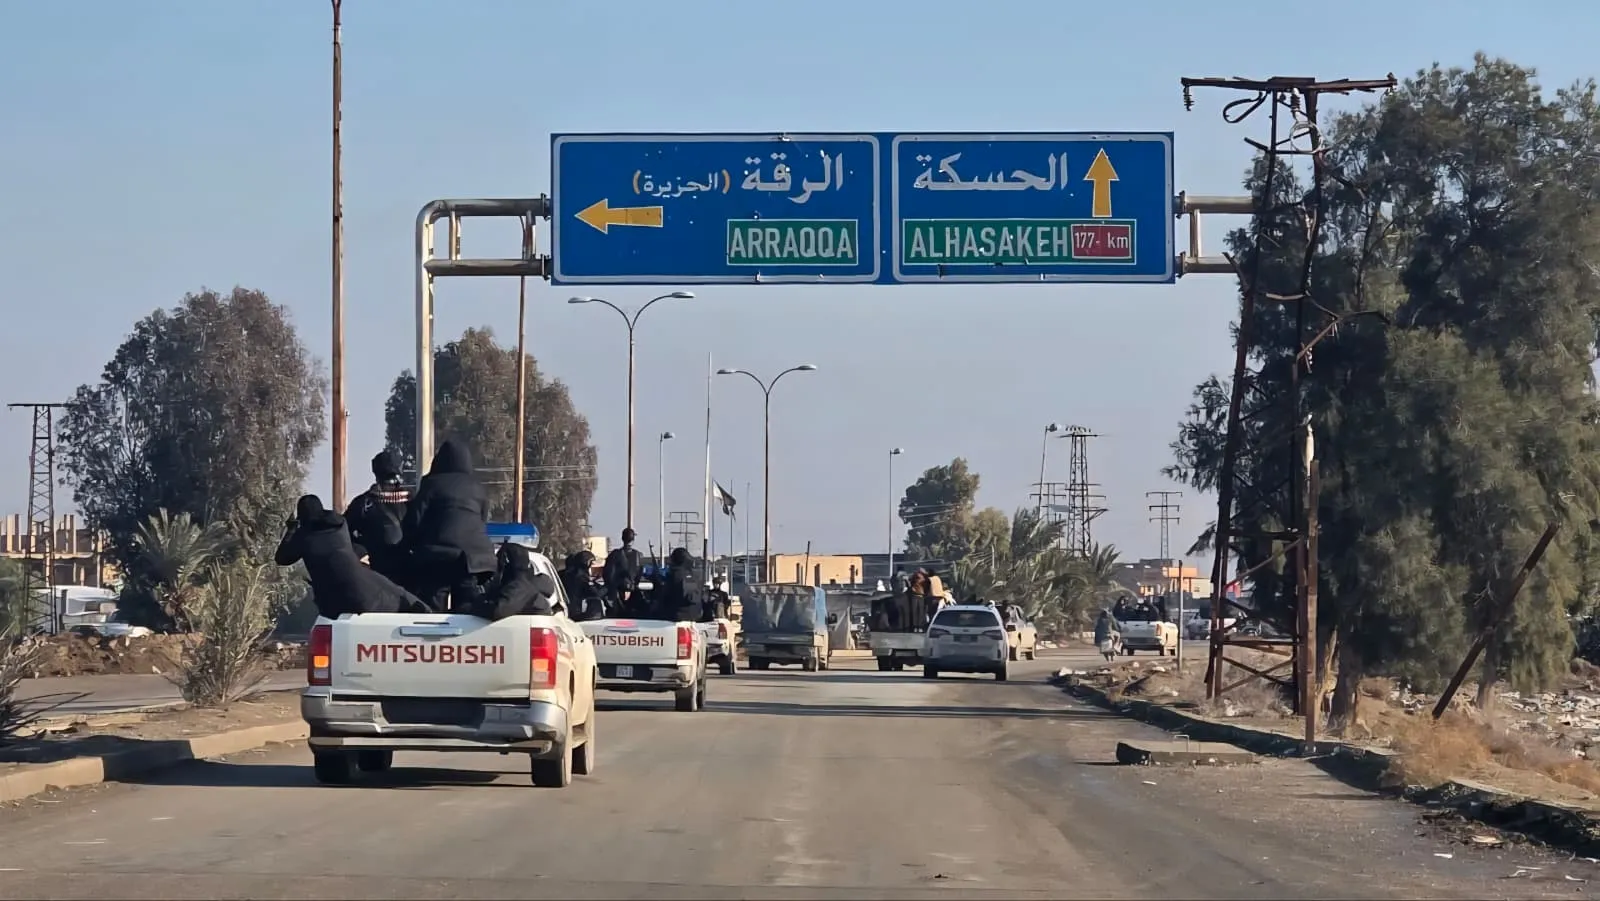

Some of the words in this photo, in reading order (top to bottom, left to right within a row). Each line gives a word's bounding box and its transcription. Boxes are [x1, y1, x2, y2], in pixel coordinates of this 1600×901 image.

[632, 169, 730, 199] (الجزيرة)
[741, 152, 844, 204] الرقة
[913, 152, 1068, 191] الحسكة
[730, 227, 853, 259] ARRAQQA
[910, 226, 1068, 258] ALHASAKEH
[1107, 231, 1128, 249] km
[356, 643, 505, 665] MITSUBISHI
